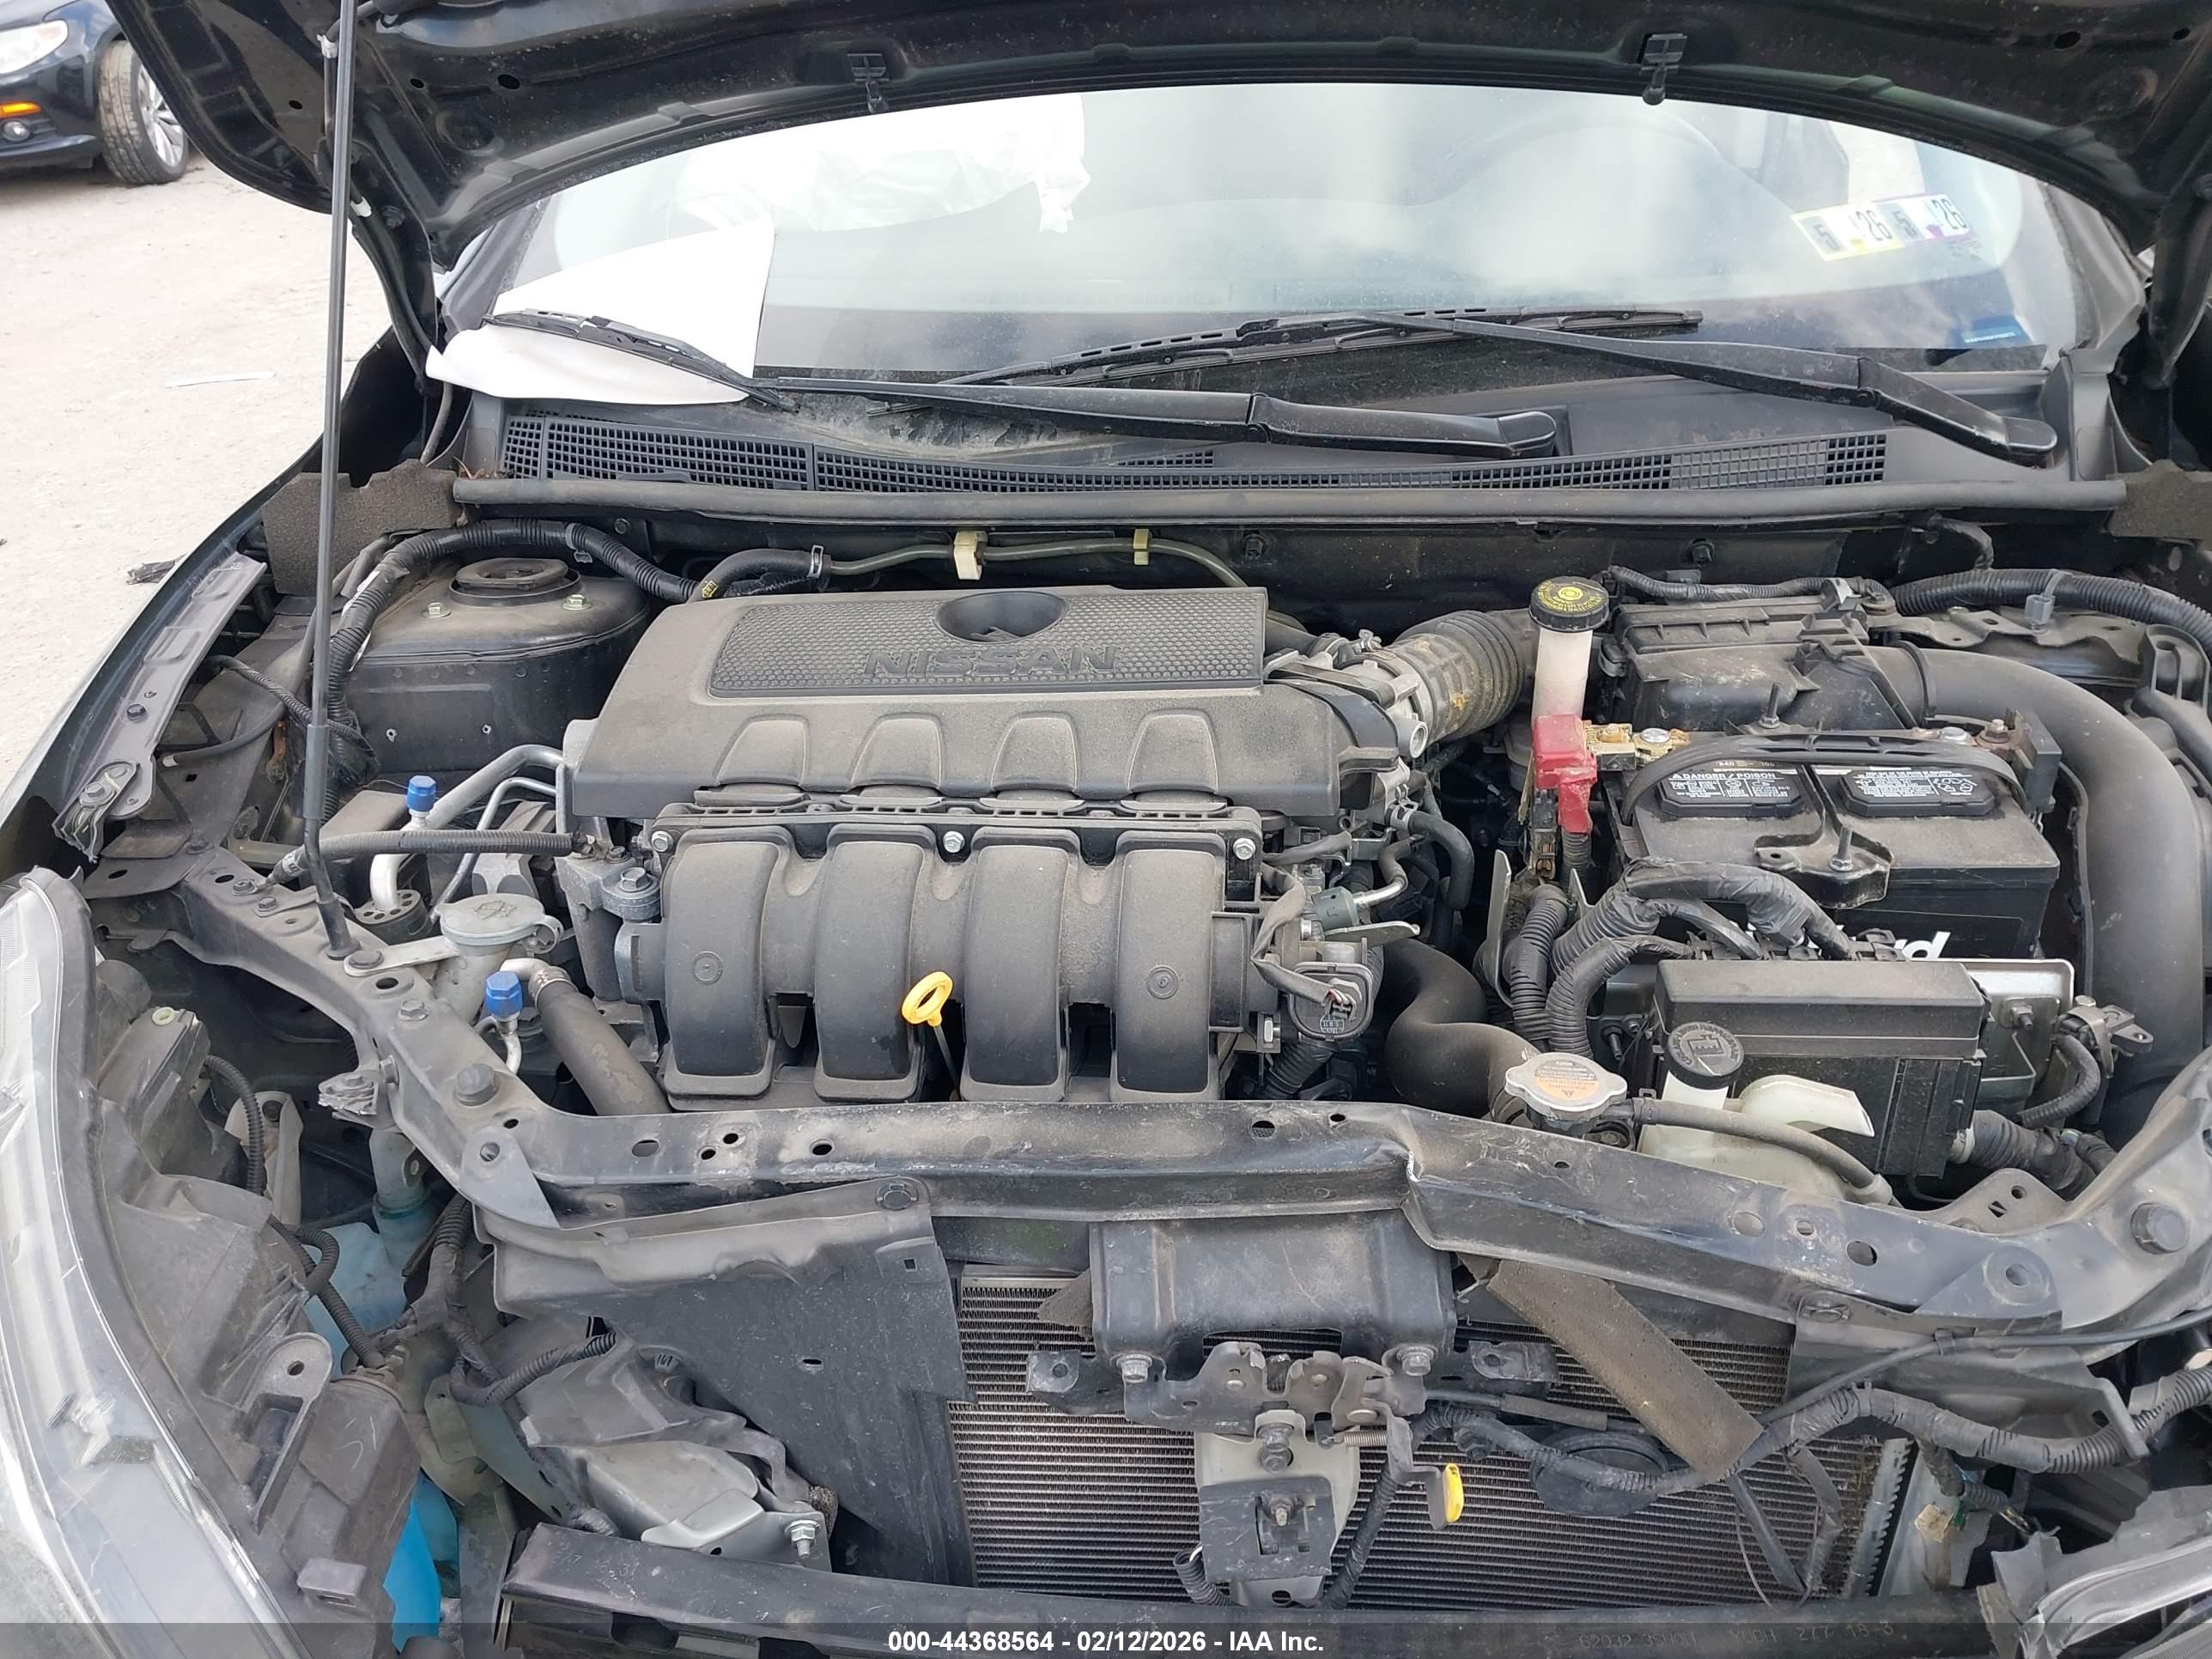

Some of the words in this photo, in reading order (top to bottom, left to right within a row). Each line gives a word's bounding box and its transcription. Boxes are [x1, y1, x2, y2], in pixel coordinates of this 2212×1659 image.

[1855, 210, 1893, 241] 26
[1931, 198, 1968, 230] 26
[863, 647, 1116, 678] NISSAN
